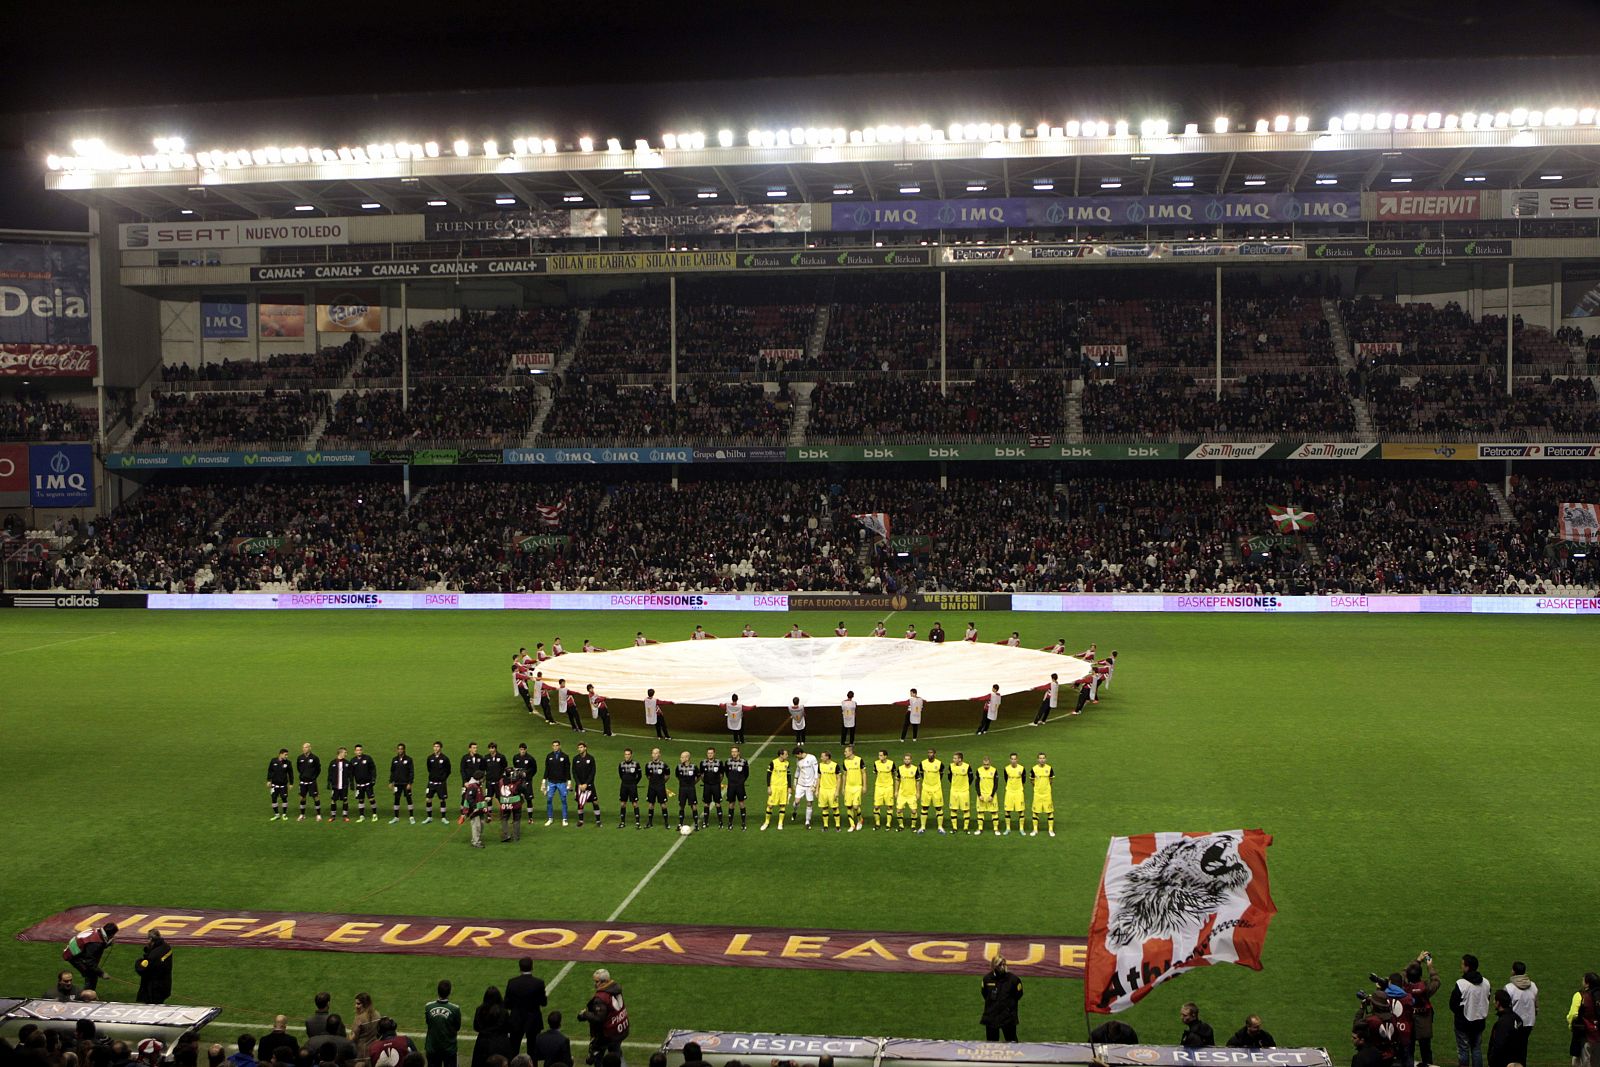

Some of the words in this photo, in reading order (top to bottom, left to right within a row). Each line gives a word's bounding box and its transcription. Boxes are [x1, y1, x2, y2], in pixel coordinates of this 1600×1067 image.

[1400, 195, 1477, 215] ENERVIT
[1549, 197, 1600, 210] SE
[961, 206, 1005, 222] IMQ
[1068, 206, 1112, 222] IMQ
[1149, 204, 1194, 220] IMQ
[1225, 203, 1271, 219] IMQ
[1303, 203, 1349, 219] IMQ
[875, 209, 918, 225] IMQ
[157, 228, 231, 242] SEAT
[246, 226, 288, 241] NUEVO
[291, 224, 341, 239] TOLEDO
[956, 250, 996, 259] Petronor
[1035, 248, 1074, 258] Petronor
[1109, 247, 1147, 257] Petronor
[1325, 248, 1353, 256] Bizkaia
[1374, 247, 1402, 255] Bizkaia
[1424, 247, 1453, 255] Bizkaia
[1475, 245, 1503, 254] Bizkaia
[600, 255, 636, 268] CABRAS
[693, 253, 731, 266] CABRAS
[753, 258, 780, 266] Bizkaia
[800, 257, 826, 265] Bizkaia
[847, 256, 873, 264] Bizkaia
[894, 255, 921, 263] Bizkaia
[314, 265, 362, 278] CANAL+
[371, 264, 419, 276] CANAL+
[429, 261, 478, 274] CANAL+
[488, 260, 537, 273] CANAL+
[258, 267, 305, 279] CANAL+
[0, 285, 88, 318] Deia
[205, 316, 243, 329] IMQ
[515, 353, 550, 365] MARCA
[612, 452, 640, 461] IMQ
[660, 451, 687, 461] IMQ
[693, 450, 715, 459] Grupo
[799, 450, 829, 459] bbk
[863, 449, 894, 458] bbk
[929, 448, 960, 457] bbk
[994, 447, 1026, 457] bbk
[1061, 447, 1093, 457] bbk
[1128, 447, 1160, 456] bbk
[1483, 446, 1523, 457] Petronor
[1547, 446, 1587, 457] Petronor
[137, 456, 168, 464] movistar
[198, 455, 229, 464] movistar
[260, 455, 292, 464] movistar
[323, 454, 355, 463] movistar
[519, 452, 545, 462] IMQ
[565, 453, 593, 462] IMQ
[35, 473, 87, 491] IMQ
[57, 595, 100, 608] adidas
[791, 599, 815, 607] UEFA
[816, 599, 851, 607] EUROPA
[855, 599, 889, 607] LEAGUE
[940, 602, 977, 610] UNION
[73, 912, 297, 939] UEFA
[323, 921, 686, 954] EUROPA
[724, 932, 1089, 969] LEAGUE
[72, 1006, 195, 1020] RESPECT
[430, 1007, 452, 1019] UEFA
[732, 1037, 864, 1053] RESPECT
[957, 1048, 1025, 1057] EUROPA
[1172, 1050, 1307, 1063] RESPECT
